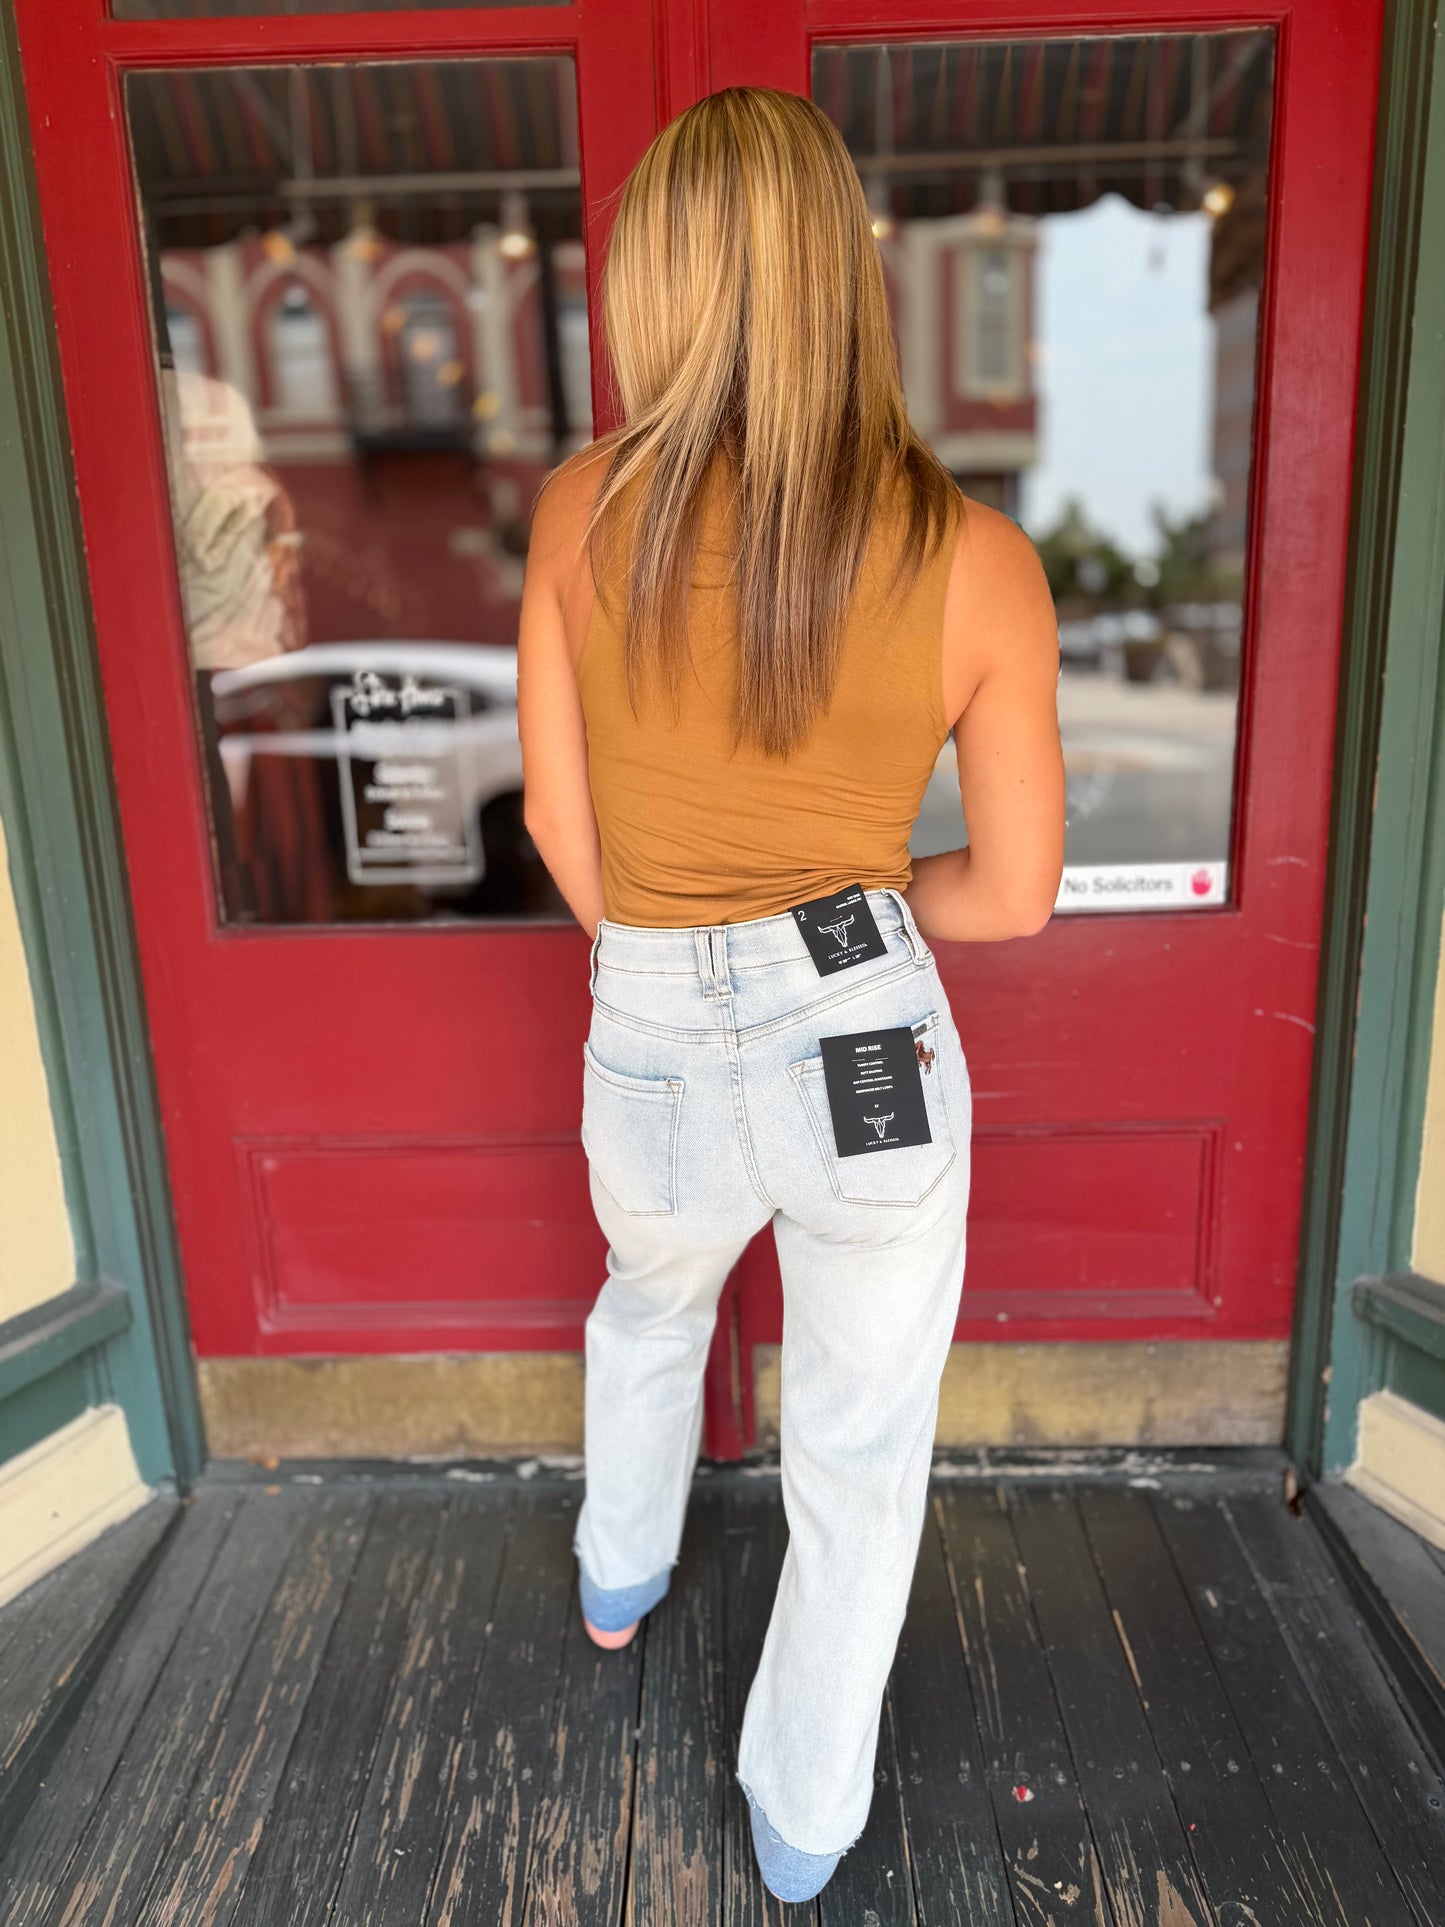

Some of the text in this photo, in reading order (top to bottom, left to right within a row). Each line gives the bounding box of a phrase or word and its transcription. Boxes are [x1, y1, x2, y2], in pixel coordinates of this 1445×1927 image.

[1064, 876, 1174, 895] No Solicitors
[797, 910, 808, 922] 2
[828, 951, 843, 960] LUCKY
[855, 1044, 882, 1054] MID RISE
